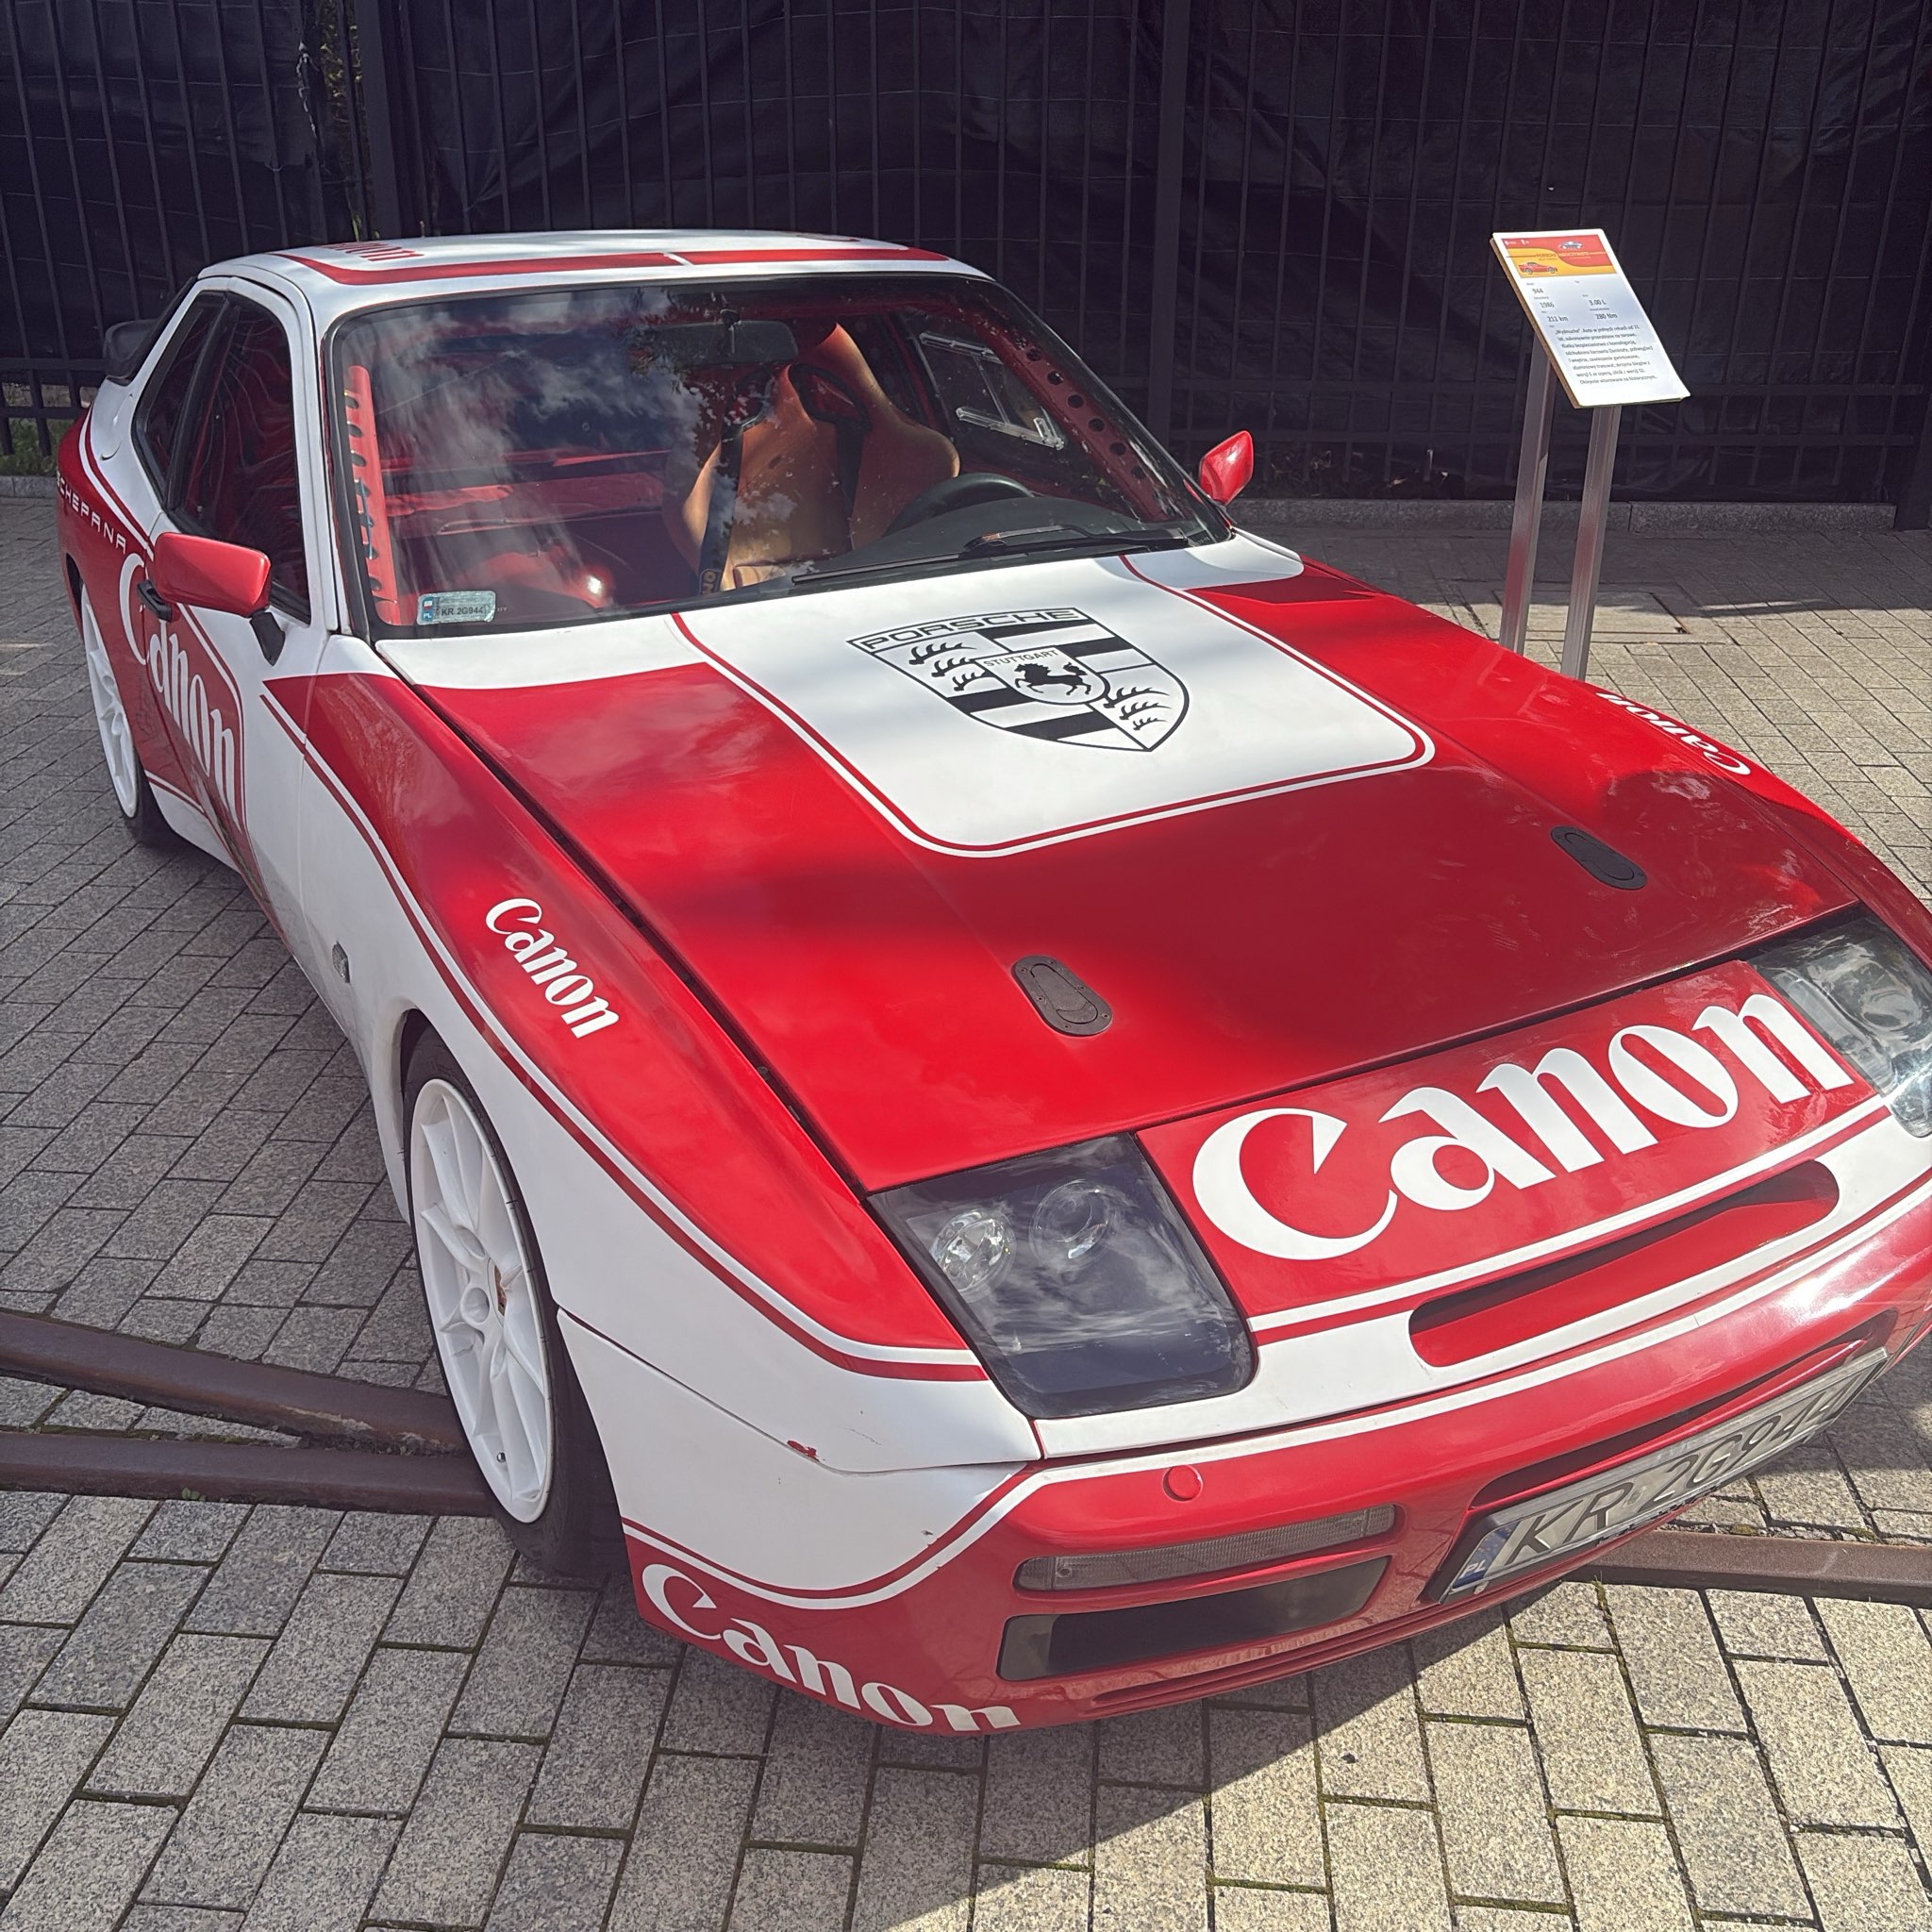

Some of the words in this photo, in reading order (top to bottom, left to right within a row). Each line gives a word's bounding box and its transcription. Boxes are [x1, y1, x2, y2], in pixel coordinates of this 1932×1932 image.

[441, 608, 455, 616] KR
[457, 607, 483, 615] 2G944
[862, 610, 1079, 650] PORSCHE
[983, 649, 1059, 668] STUTTGART
[1595, 692, 1752, 775] Canon
[486, 898, 620, 1039] Canon
[1192, 993, 1854, 1260] Canon
[1504, 1482, 1637, 1566] KR
[1458, 1559, 1487, 1579] PL
[641, 1562, 1022, 1732] Canon
